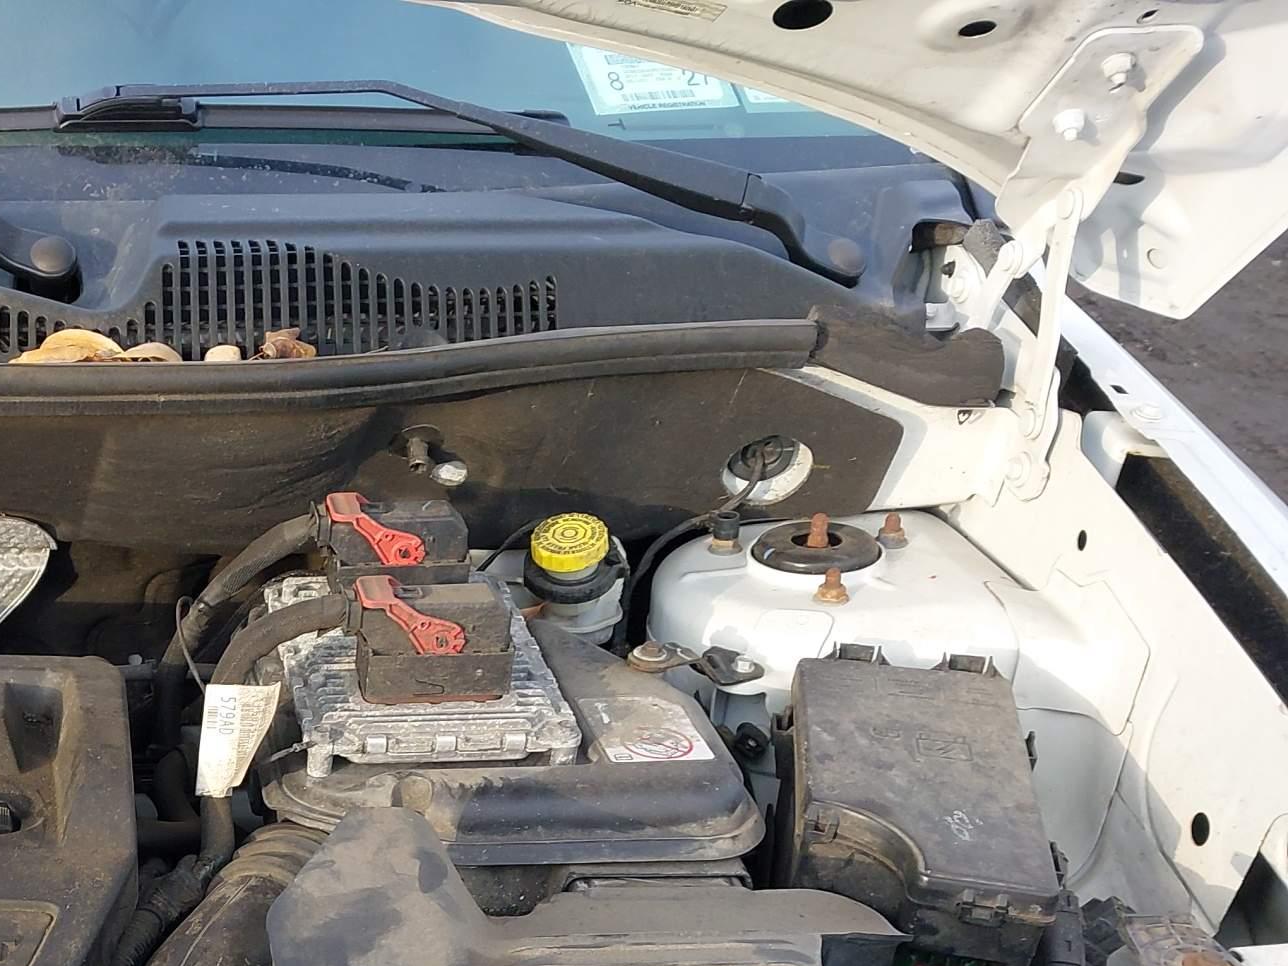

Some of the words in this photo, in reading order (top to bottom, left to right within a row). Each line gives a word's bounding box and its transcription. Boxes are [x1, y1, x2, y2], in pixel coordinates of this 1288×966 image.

[607, 71, 624, 91] 8
[629, 103, 657, 111] VEHICLE
[658, 101, 706, 109] REGISTRATION
[219, 696, 237, 735] 579AD
